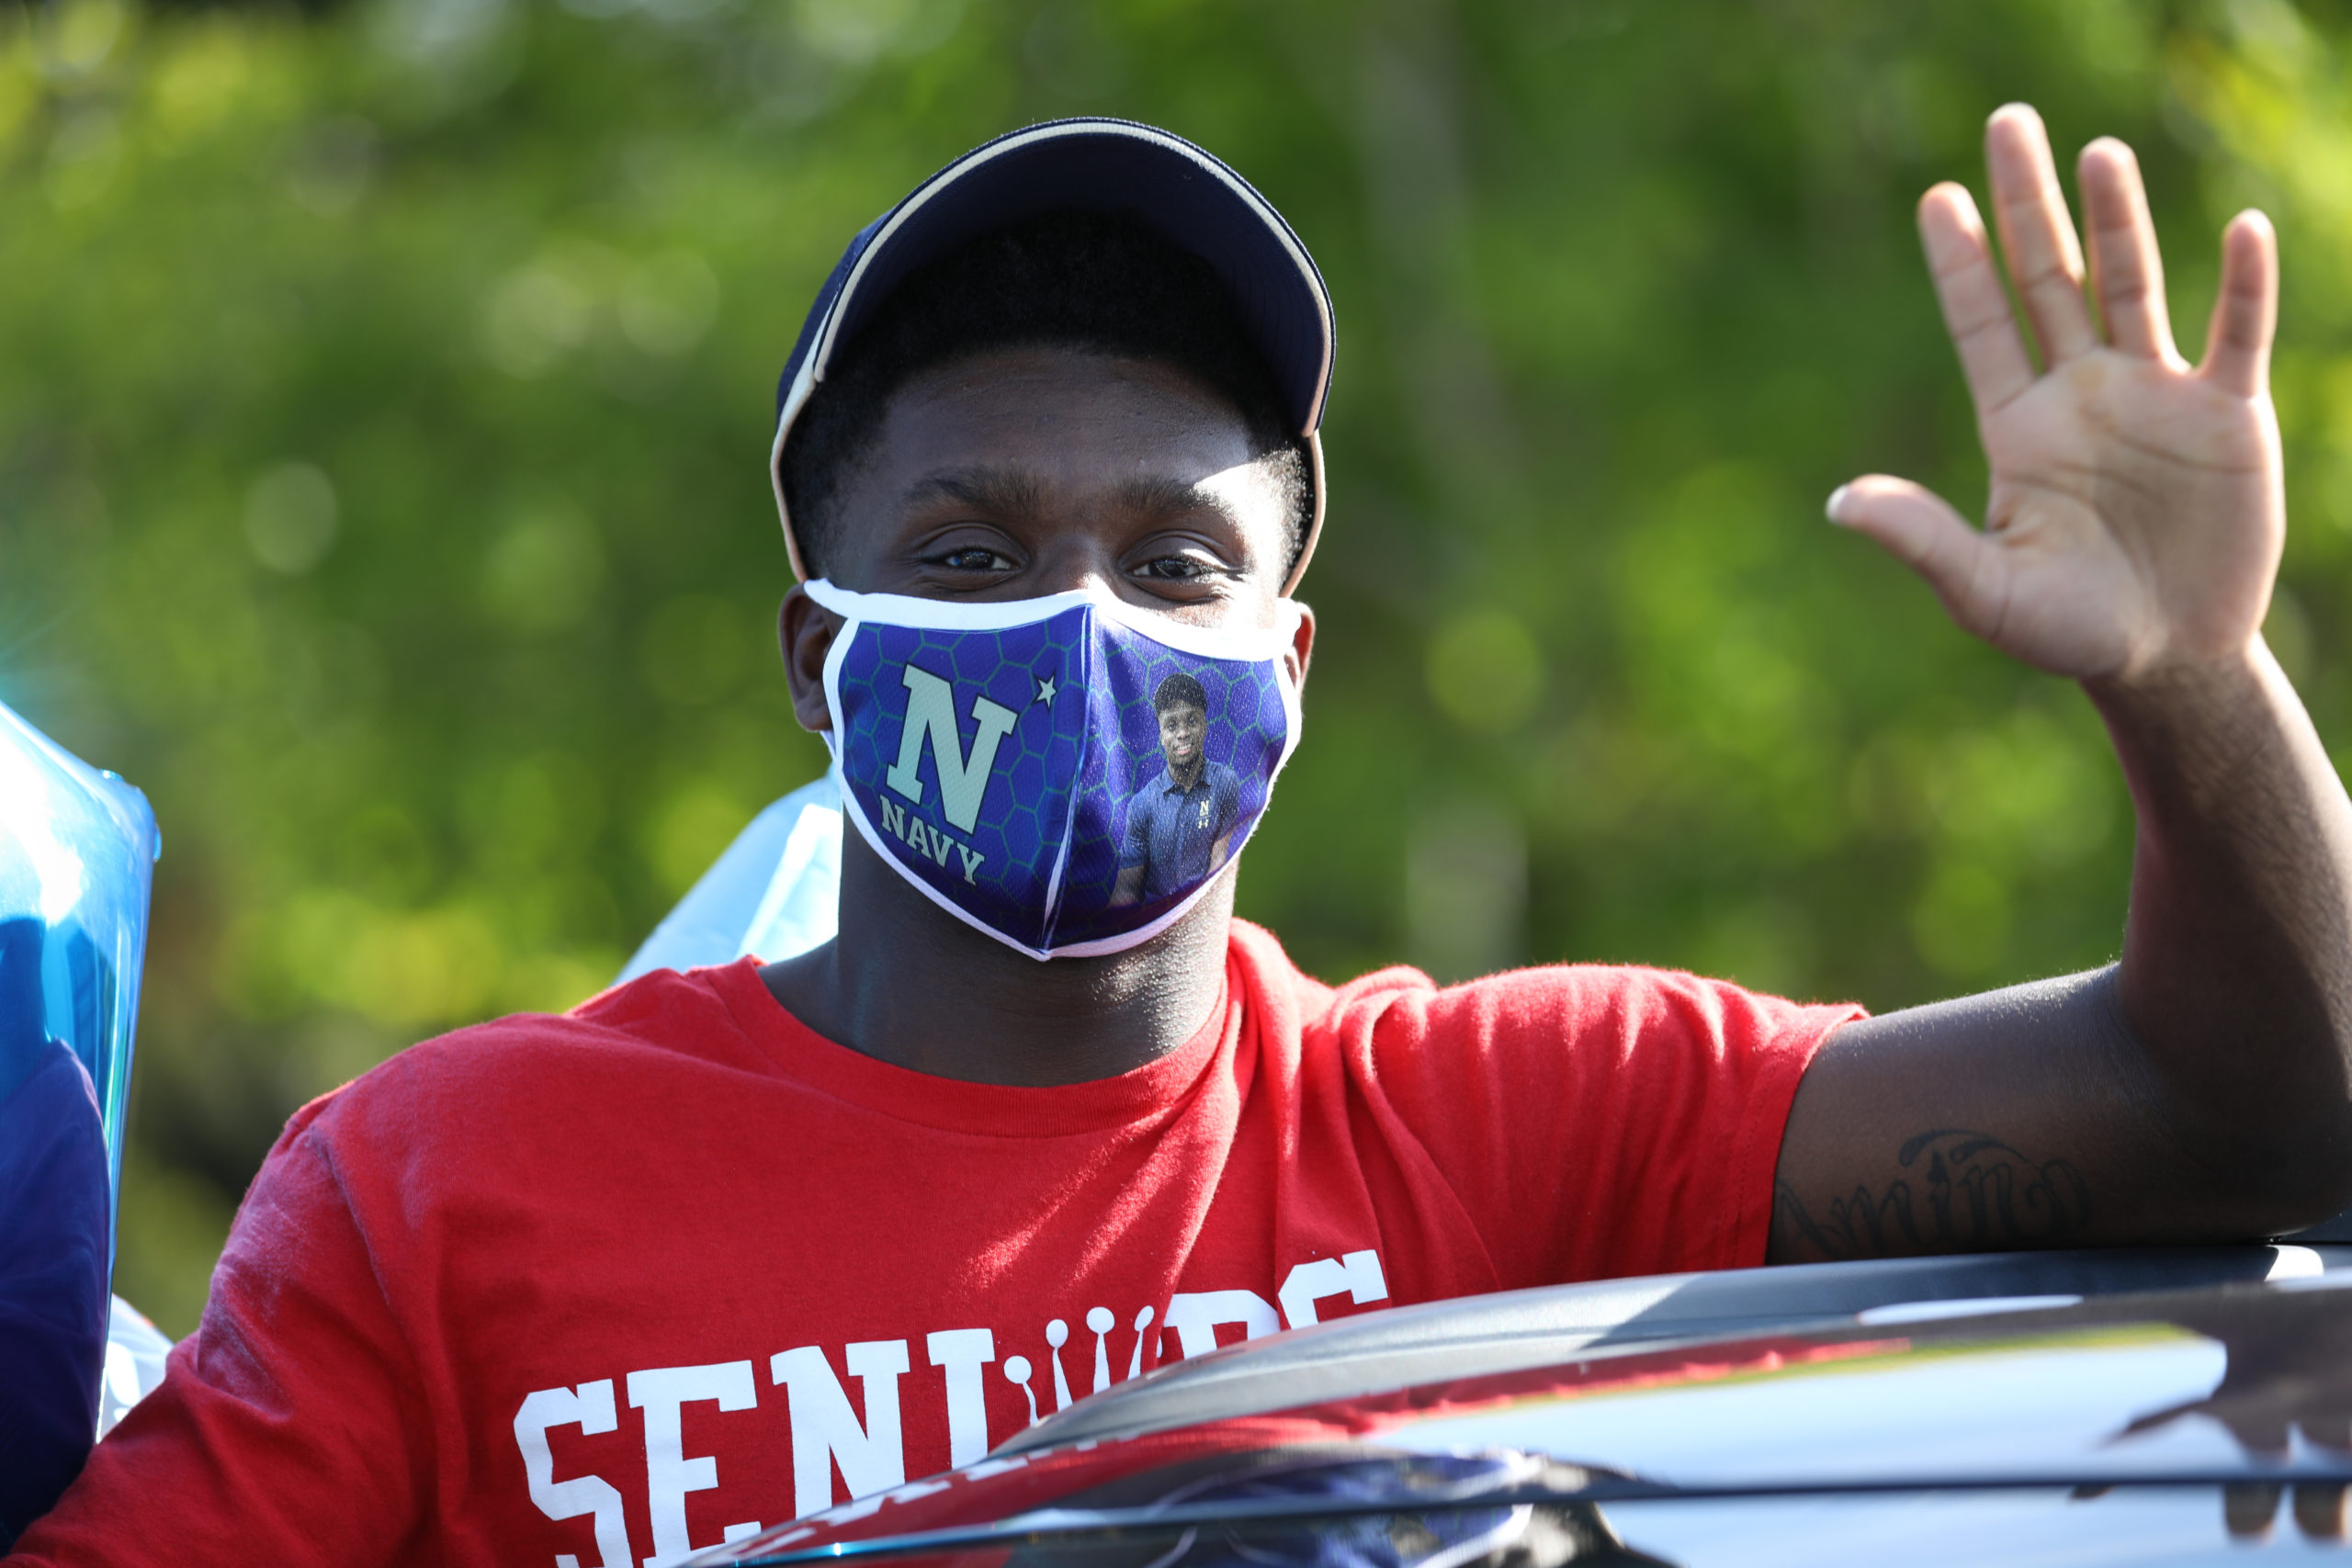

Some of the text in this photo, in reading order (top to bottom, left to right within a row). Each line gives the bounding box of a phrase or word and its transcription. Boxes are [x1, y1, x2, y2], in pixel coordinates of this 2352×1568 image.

[885, 661, 1019, 836] N
[879, 794, 986, 886] NAVY
[1199, 799, 1210, 814] N
